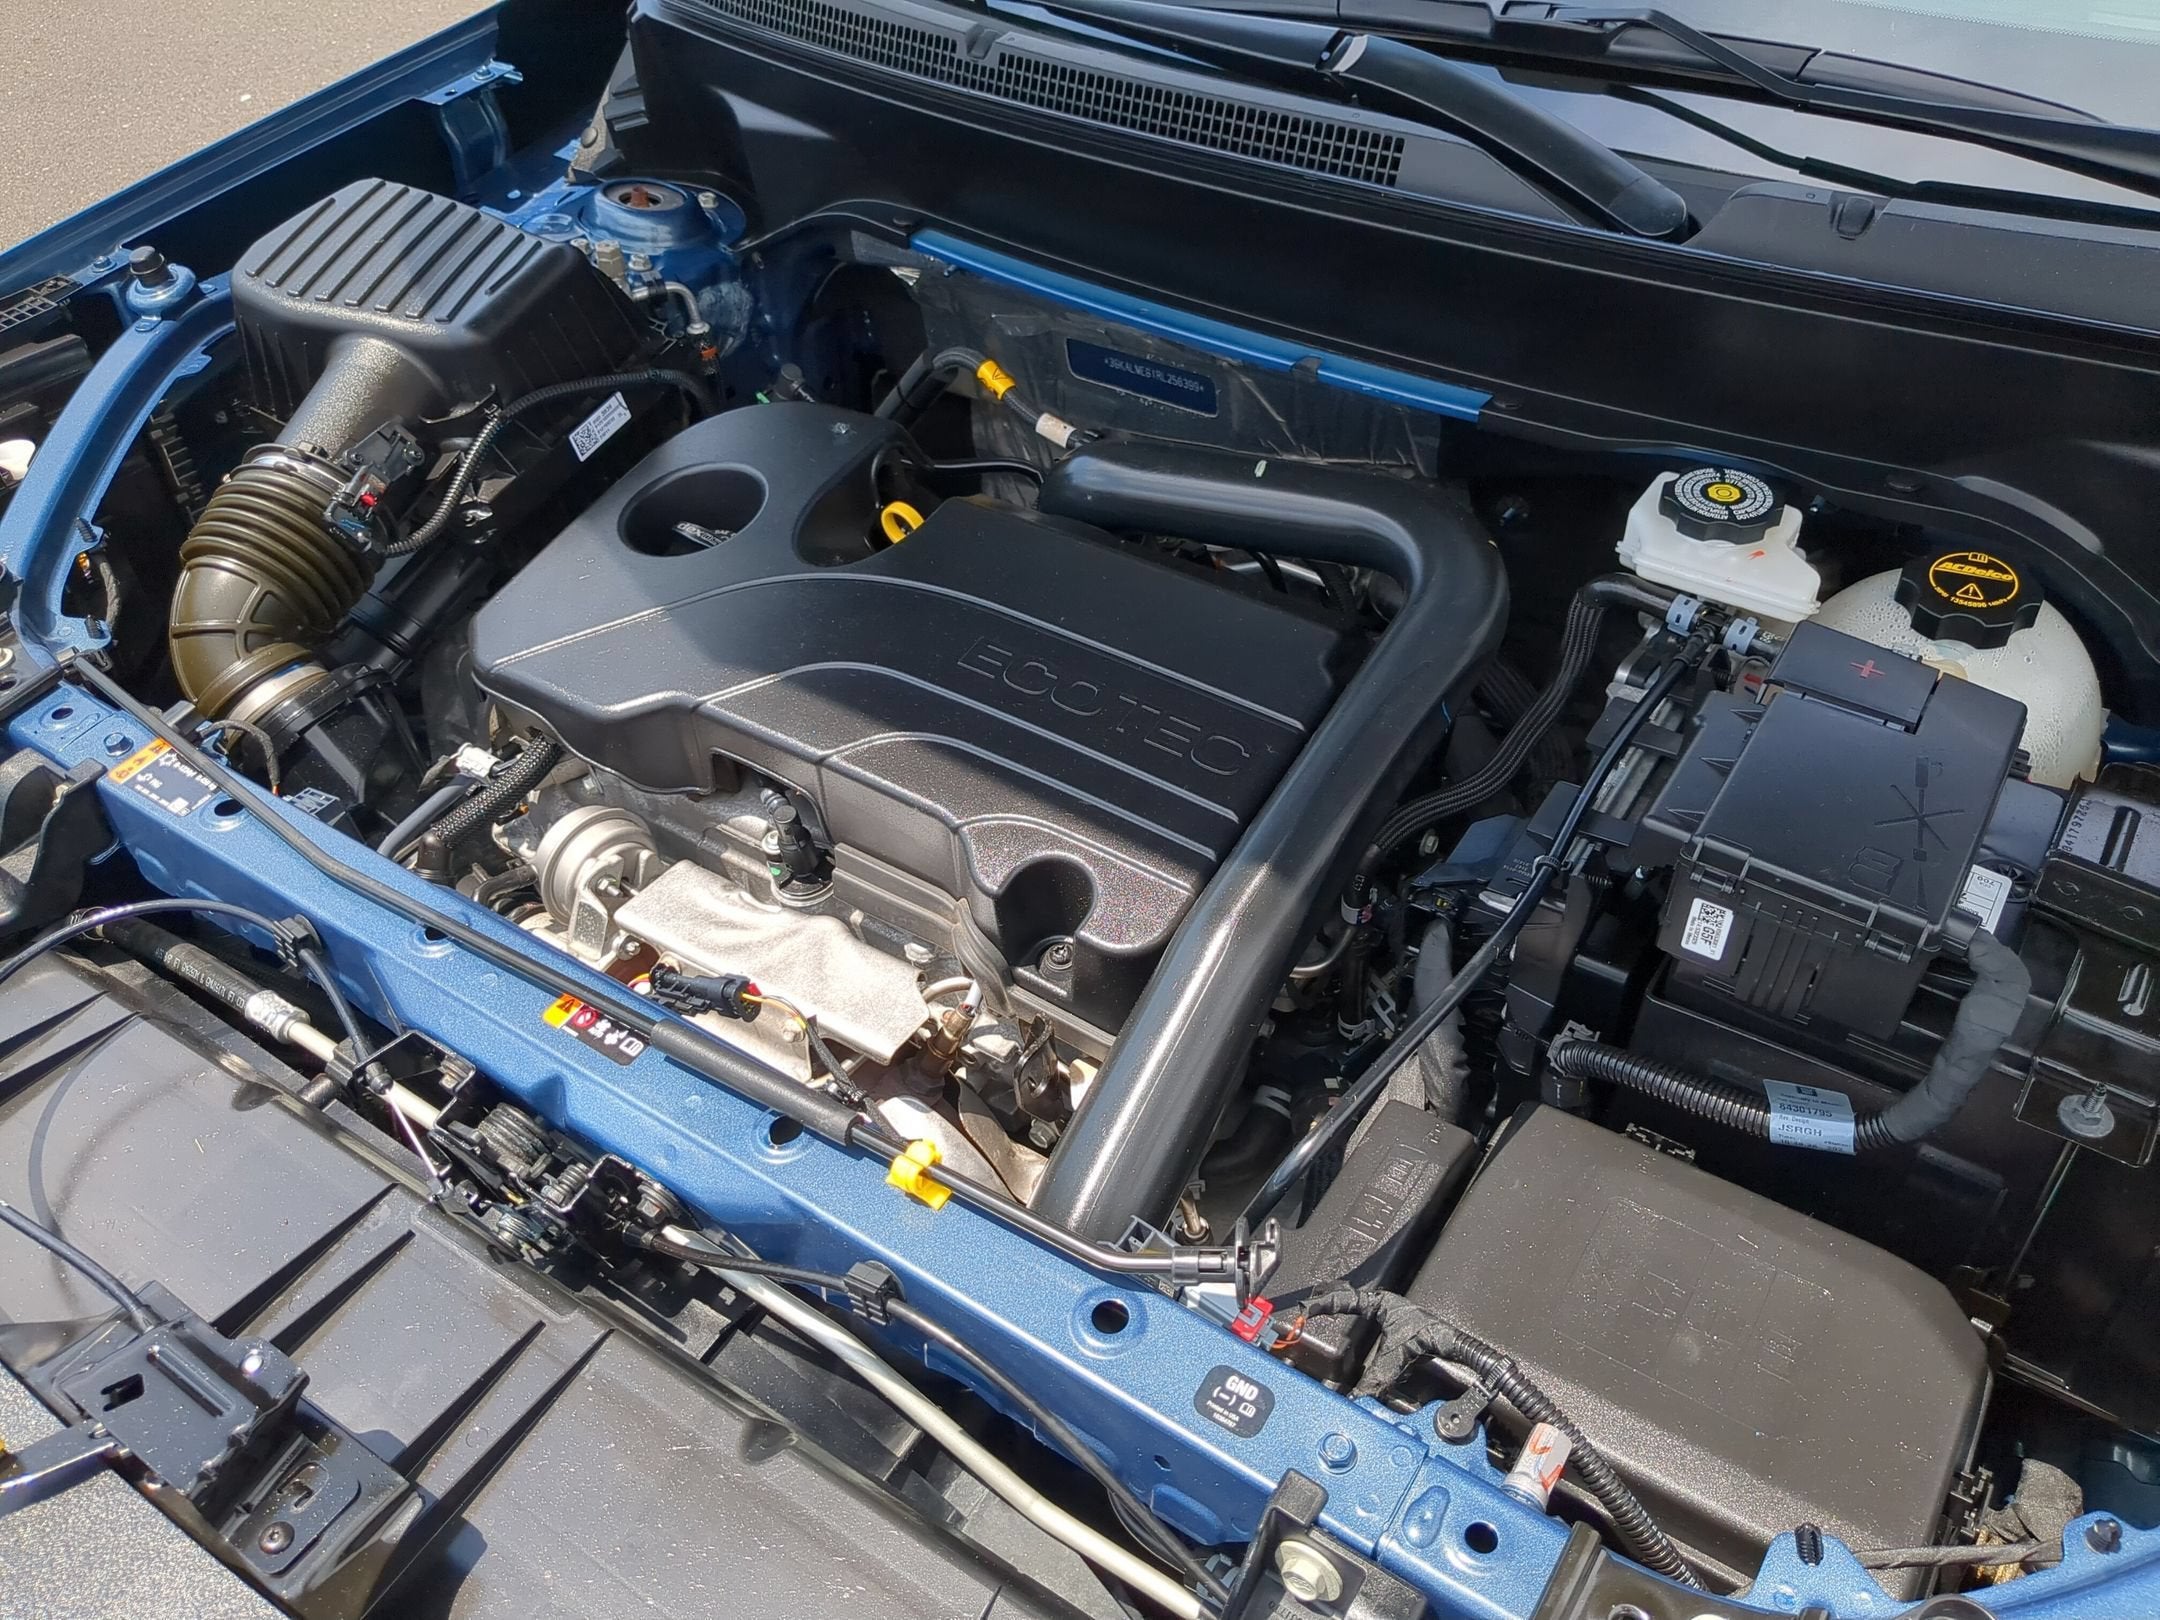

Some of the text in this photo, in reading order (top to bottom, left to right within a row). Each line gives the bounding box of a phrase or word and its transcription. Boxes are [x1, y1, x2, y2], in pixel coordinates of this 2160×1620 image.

[1937, 561, 2014, 581] ACDelco
[957, 635, 1250, 776] ECOTEC
[1976, 875, 1995, 886] 700
[1700, 926, 1715, 946] G5F
[1225, 1374, 1259, 1402] GND
